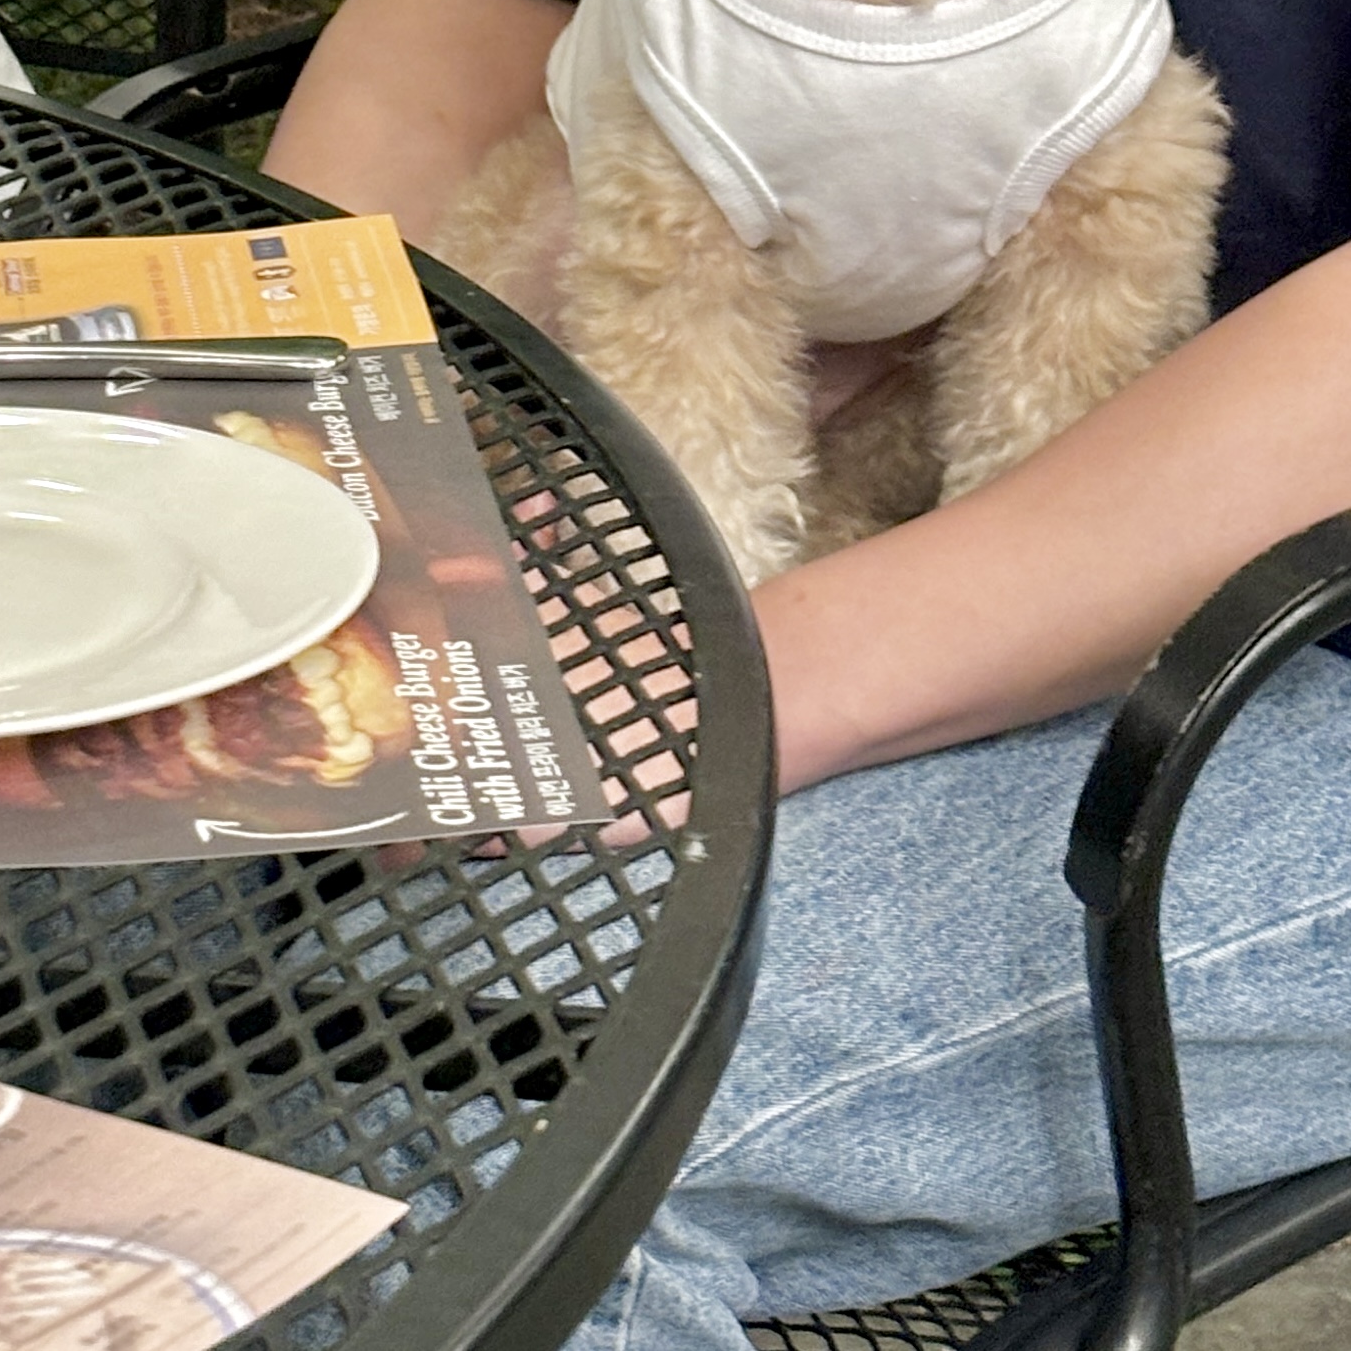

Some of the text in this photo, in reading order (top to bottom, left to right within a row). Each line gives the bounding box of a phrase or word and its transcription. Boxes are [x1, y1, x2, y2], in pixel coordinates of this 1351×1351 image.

[307, 369, 349, 412] Burg
[321, 414, 362, 468] Cheese
[390, 631, 476, 825] Chili Cheese Burger
[441, 641, 525, 820] with Fried Onions
[497, 664, 576, 816] 어니언 프라이 칠리 치즈 버거
